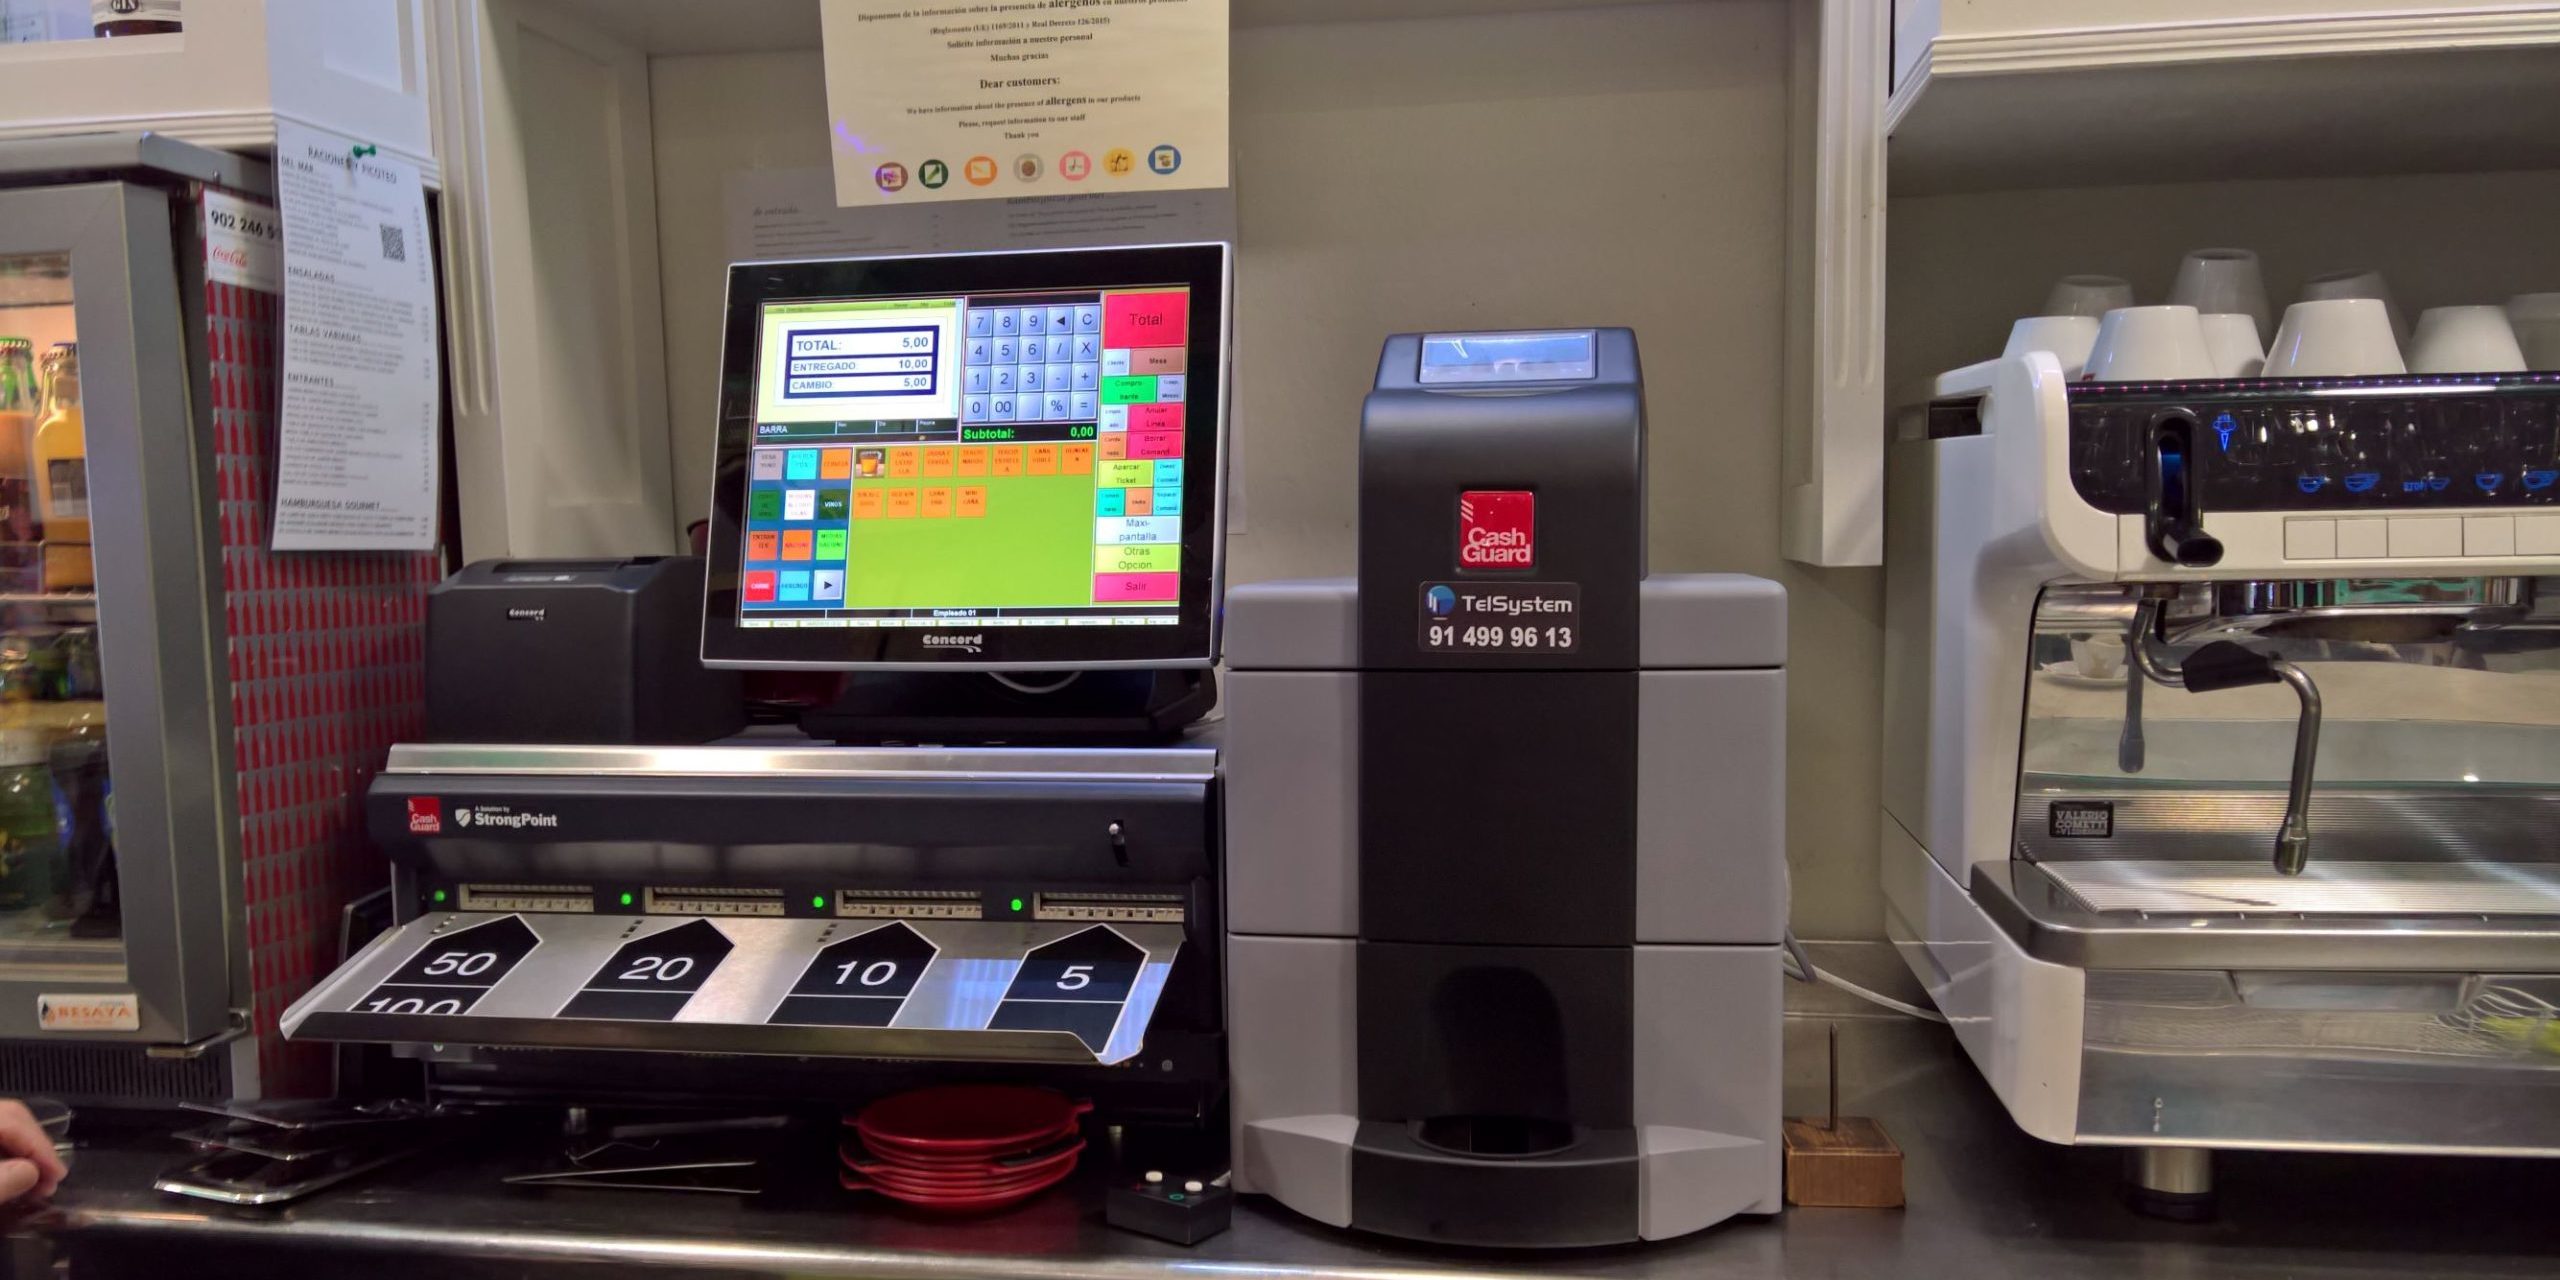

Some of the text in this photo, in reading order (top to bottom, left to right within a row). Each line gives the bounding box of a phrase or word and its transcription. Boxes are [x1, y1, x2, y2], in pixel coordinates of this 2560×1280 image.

[903, 10, 912, 18] de
[1000, 3, 1036, 12] presencia
[1032, 20, 1048, 28] Real
[1049, 19, 1076, 28] Decreto
[947, 40, 974, 49] Solicite
[976, 36, 1021, 47] información
[1029, 36, 1059, 44] nuestro
[1060, 33, 1093, 44] personal
[990, 52, 1049, 62] Muchas gracias
[980, 76, 1061, 90] Dear customers:
[935, 103, 973, 113] information
[974, 102, 993, 111] about
[995, 101, 1006, 109] the
[1045, 95, 1087, 107] allergens
[982, 118, 1006, 128] request
[1007, 115, 1047, 125] information
[1070, 113, 1086, 122] staff
[1004, 131, 1040, 140] Thank you
[281, 155, 314, 173] DEL MAR
[211, 209, 236, 229] 902
[240, 217, 263, 238] 246
[287, 265, 336, 284] ENSALADAS
[976, 313, 1092, 329] 7 8 9 C
[1129, 312, 1163, 326] Total
[289, 323, 362, 345] TABLAS VARIADAS
[796, 337, 929, 352] TOTAL: 5,00
[974, 345, 983, 356] 4
[1001, 344, 1010, 356] 5
[1027, 343, 1037, 355] 6
[1081, 341, 1091, 354] X
[898, 359, 929, 370] 10,00
[287, 372, 335, 388] ENTRANTES
[903, 377, 927, 388] 5,00
[974, 373, 980, 385] 1
[1000, 372, 1009, 385] 2
[1026, 371, 1036, 384] 3
[972, 401, 981, 414] 0
[995, 400, 1012, 413] 00
[1050, 399, 1063, 412] %
[759, 424, 788, 435] BARRA
[963, 426, 1094, 440] Subtotal: 0,00
[281, 498, 381, 511] HAMBURGUESA GOURMET
[1119, 533, 1157, 542] pantalla
[1468, 527, 1526, 547] Cash
[1124, 547, 1151, 556] Otras
[1462, 543, 1531, 563] Guard
[1125, 582, 1147, 591] Salir
[933, 608, 977, 618] Empleado 01
[1461, 595, 1573, 616] TelSystem
[922, 633, 983, 646] Concord
[1429, 626, 1572, 648] 91 499 96 13
[411, 813, 438, 824] Cash
[474, 812, 558, 829] StrongPoint
[2056, 810, 2108, 820] VALERIO
[410, 821, 440, 832] Guard
[423, 951, 498, 977] 50
[617, 956, 694, 981] 20
[834, 961, 898, 986] 10
[1055, 965, 1095, 990] 5
